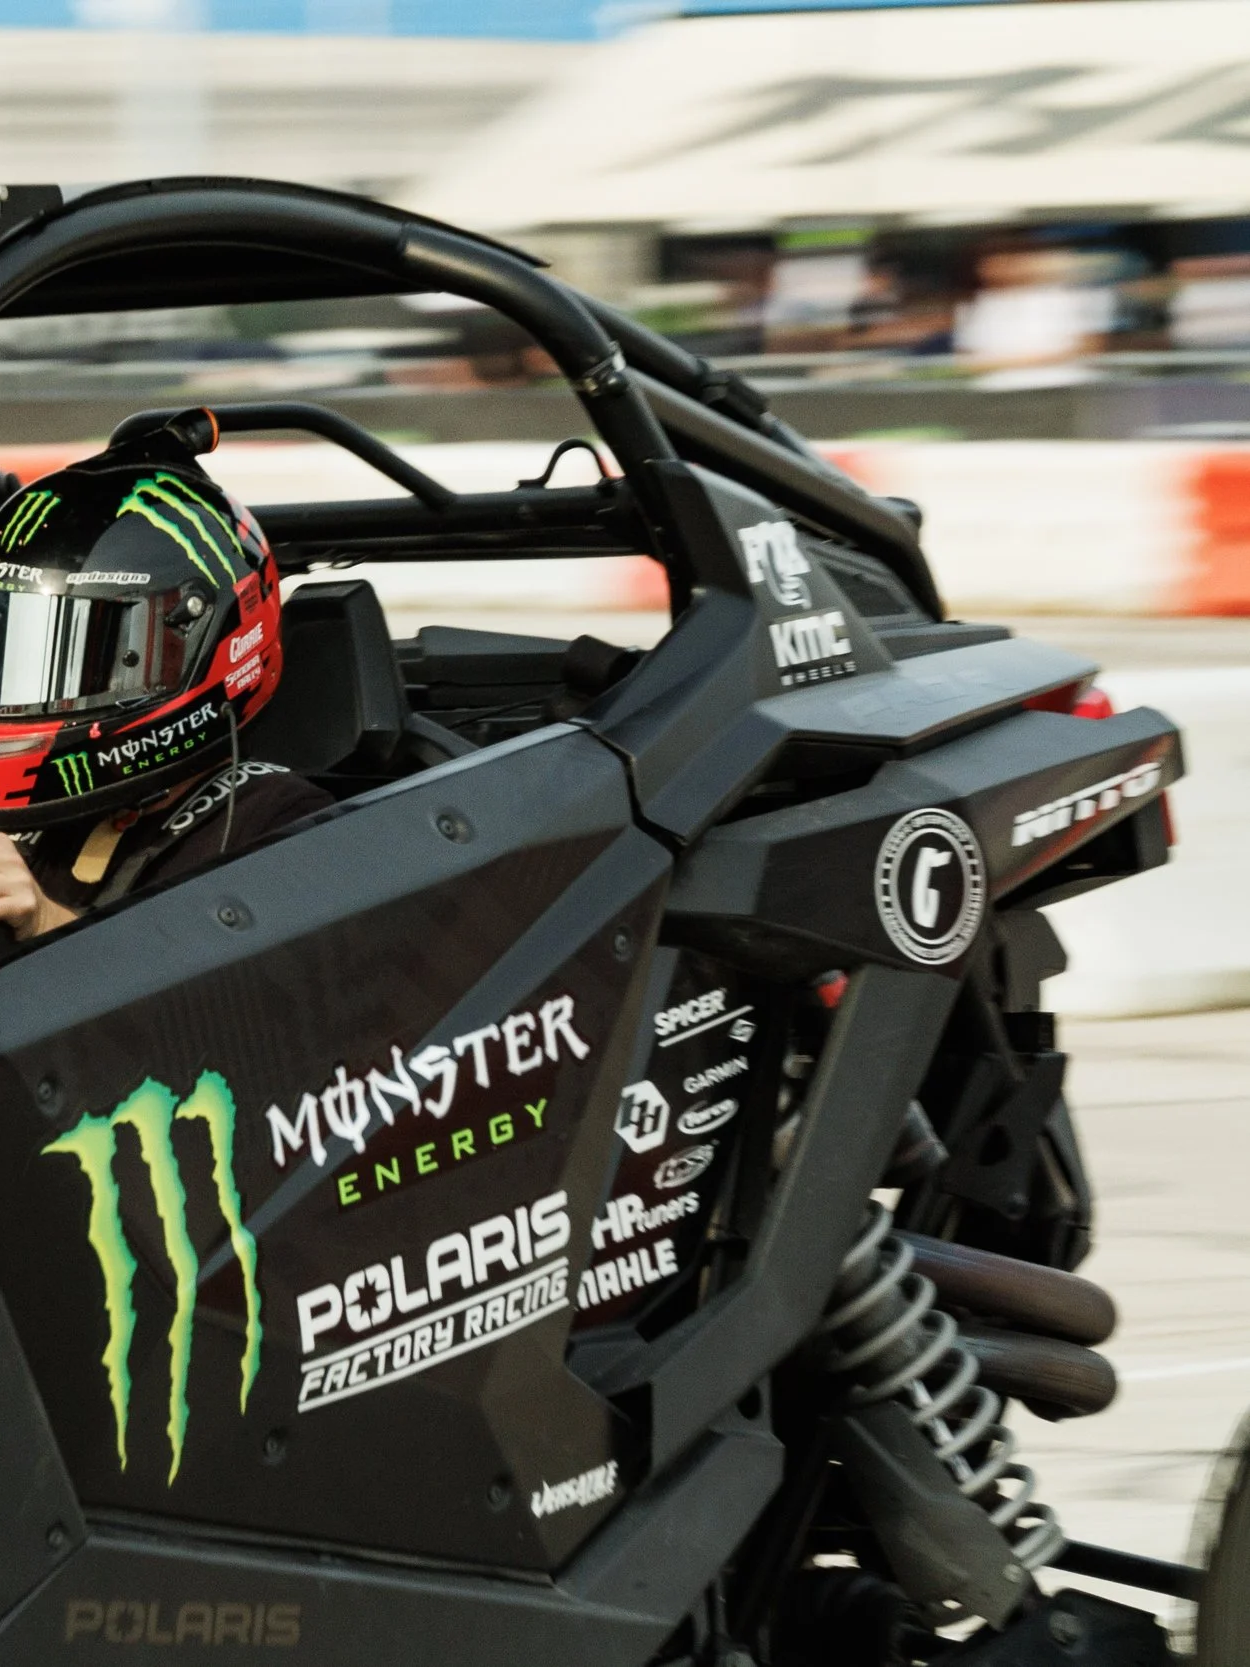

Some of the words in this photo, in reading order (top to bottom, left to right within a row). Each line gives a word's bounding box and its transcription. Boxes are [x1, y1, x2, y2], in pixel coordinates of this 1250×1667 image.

[769, 611, 852, 668] KMC
[97, 702, 218, 767] MONSTER
[122, 732, 206, 775] ENERGY
[169, 760, 291, 831] sparco
[654, 989, 726, 1036] SPICER
[265, 995, 590, 1167] MONSTER
[683, 1055, 749, 1094] GARMIN
[337, 1098, 548, 1207] ENERGY
[297, 1190, 570, 1354] POLARIS
[299, 1318, 454, 1402] FACTORY
[464, 1266, 569, 1340] RACING
[64, 1599, 301, 1647] POLARIS
